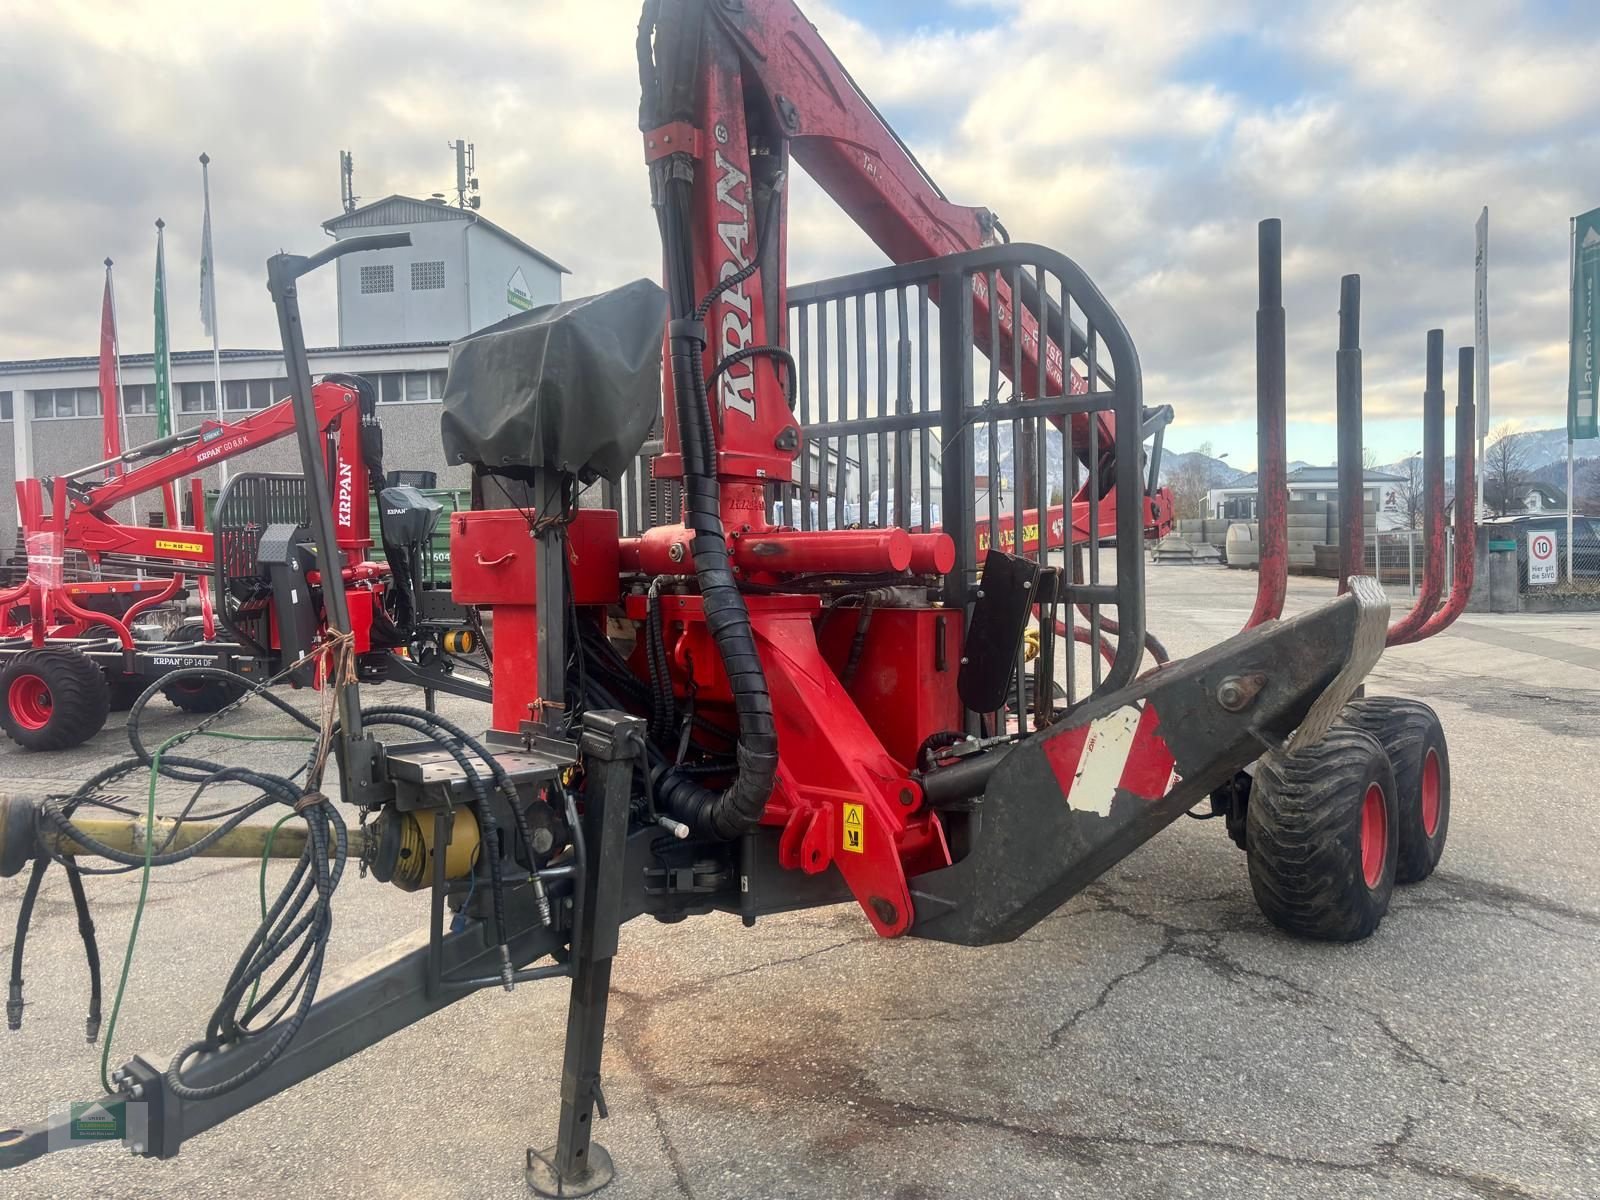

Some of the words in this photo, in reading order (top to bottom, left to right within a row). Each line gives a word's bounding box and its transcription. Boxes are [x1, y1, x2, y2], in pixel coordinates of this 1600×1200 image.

[1537, 542, 1547, 553] 10
[183, 657, 193, 666] GP
[194, 658, 202, 666] 14
[203, 658, 212, 667] DF
